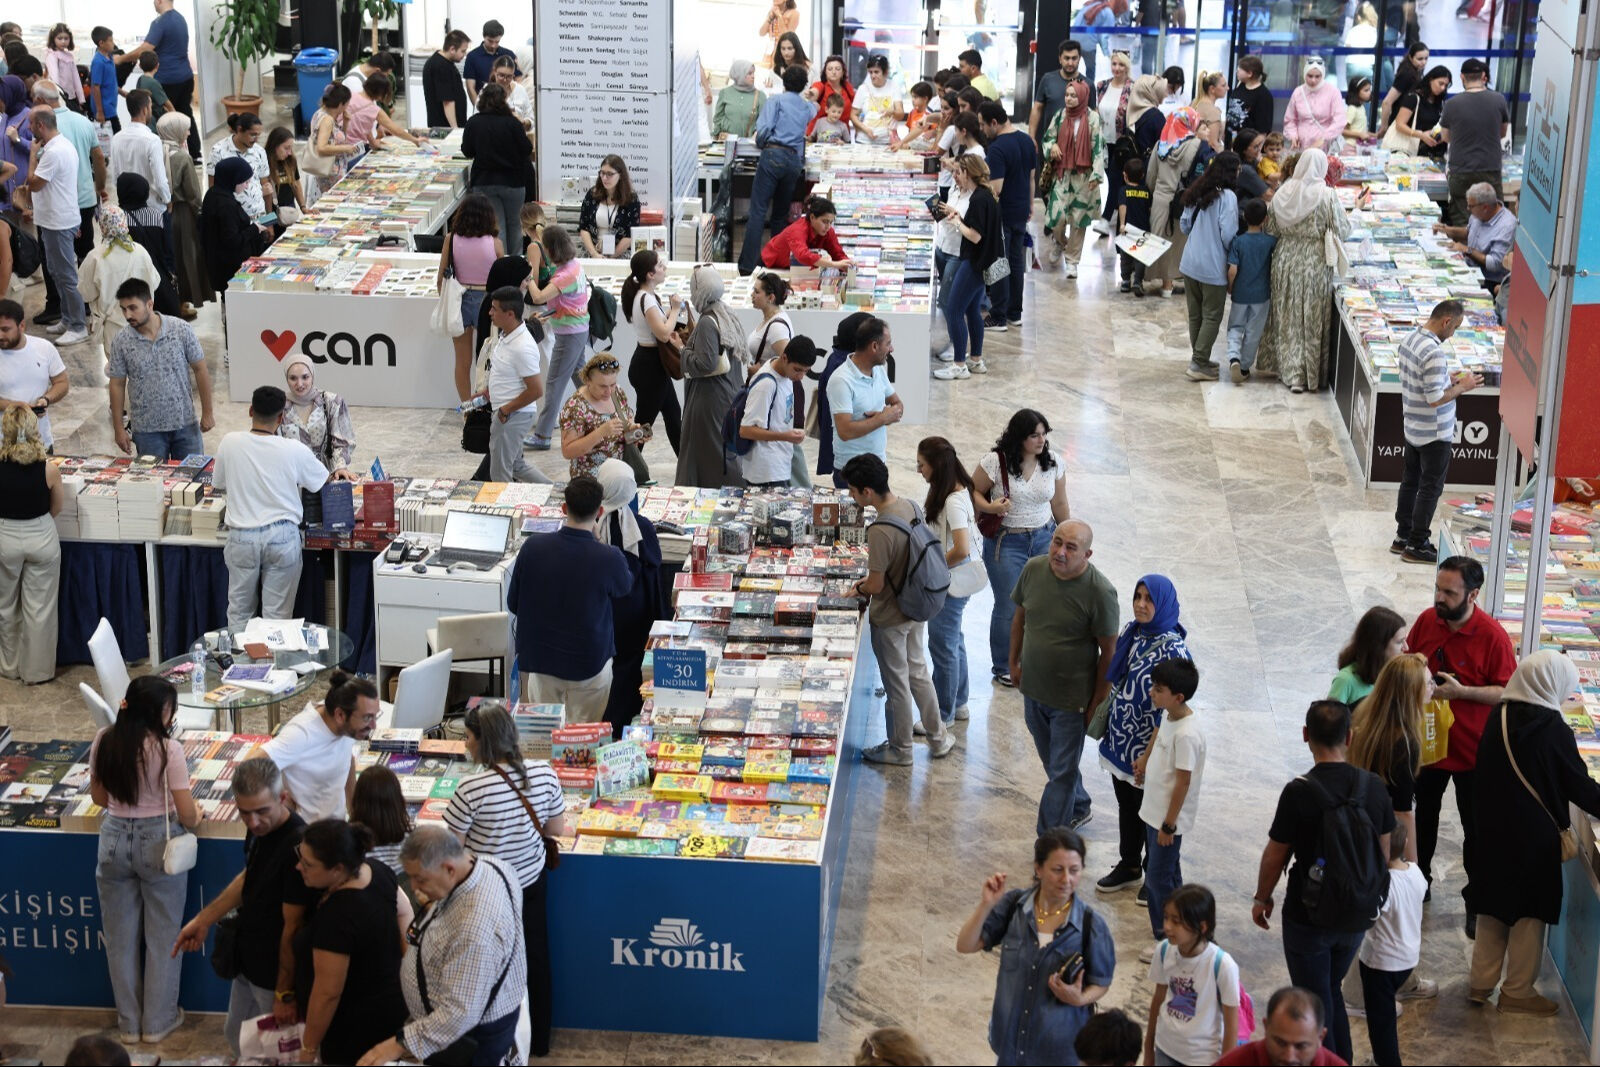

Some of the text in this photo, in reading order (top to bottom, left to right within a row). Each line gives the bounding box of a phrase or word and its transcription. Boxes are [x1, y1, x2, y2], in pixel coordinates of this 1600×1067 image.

[596, 47, 616, 55] Sontag
[629, 82, 648, 91] Süreya
[301, 331, 396, 367] can
[1378, 446, 1499, 460] YAPI YAYINL
[662, 678, 698, 687] İNDİRİM
[0, 889, 94, 920] KİŞİSE
[610, 936, 746, 972] Kronik
